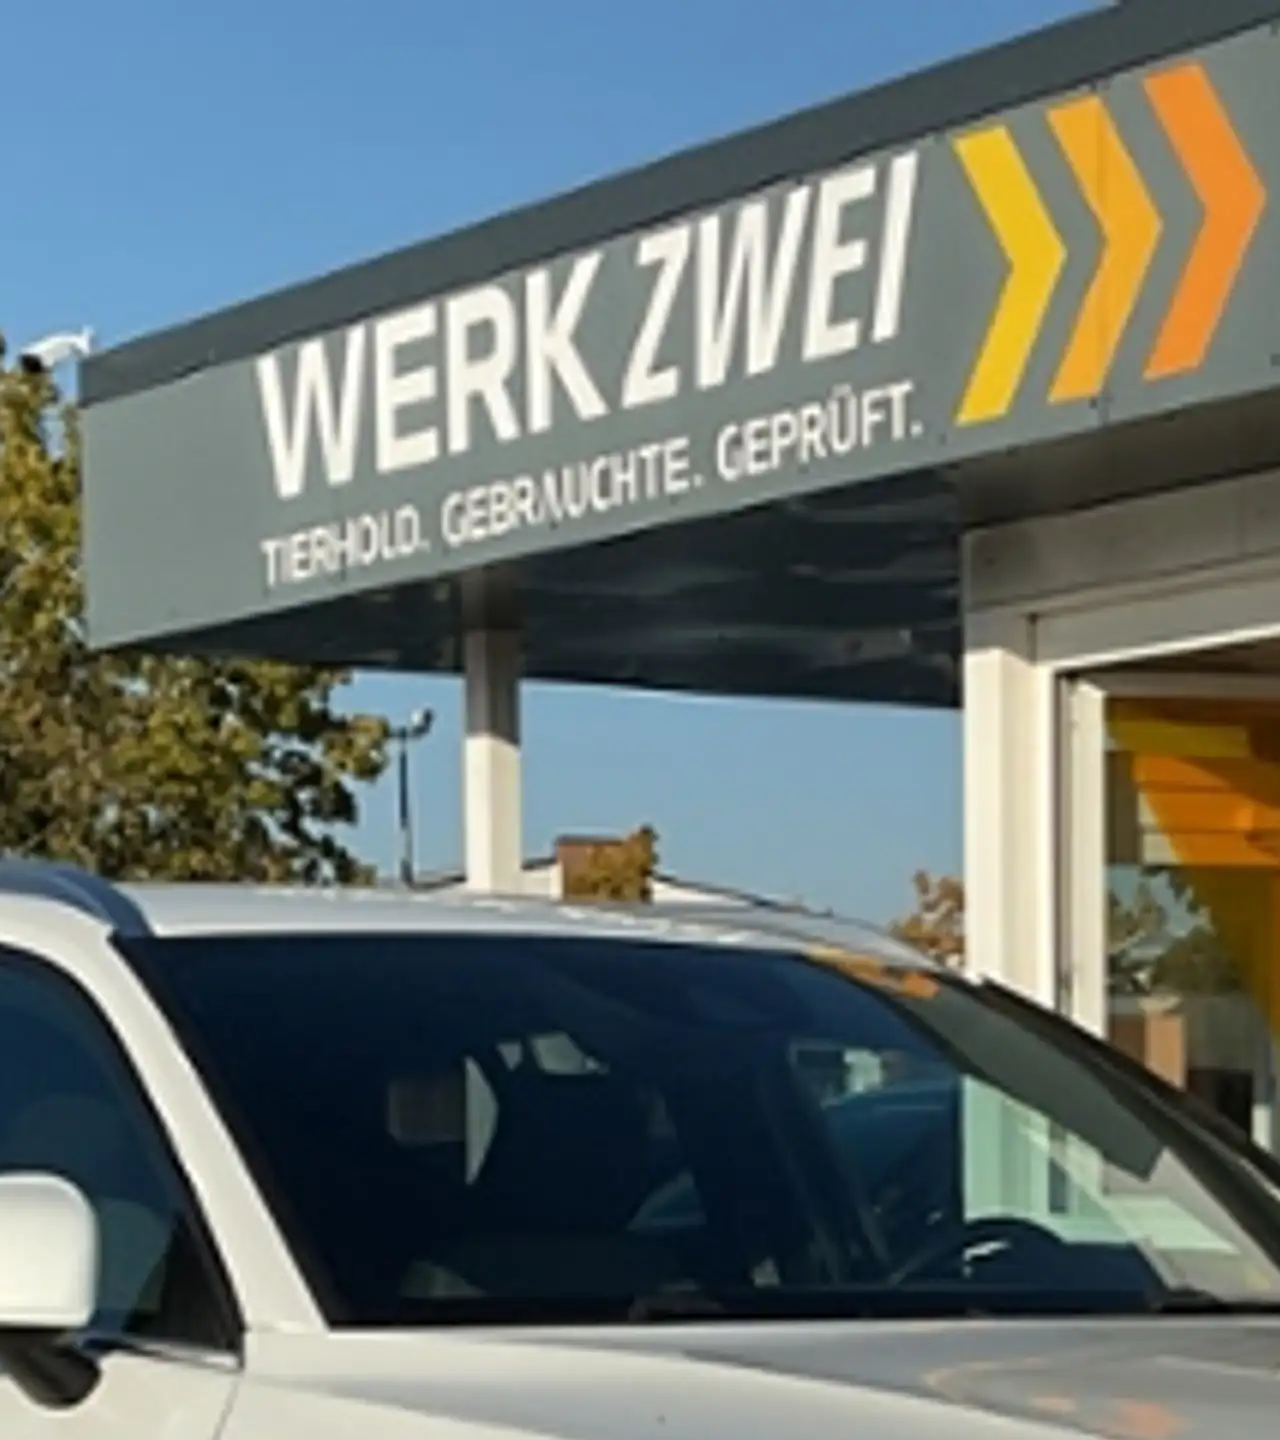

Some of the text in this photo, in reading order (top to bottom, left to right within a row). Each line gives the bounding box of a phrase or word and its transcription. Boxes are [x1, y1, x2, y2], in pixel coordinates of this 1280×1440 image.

[255, 150, 920, 501] WERK ZWEI
[260, 381, 923, 588] TIERHOLD. GEBRAUCHTE. GEPRÜFT.
